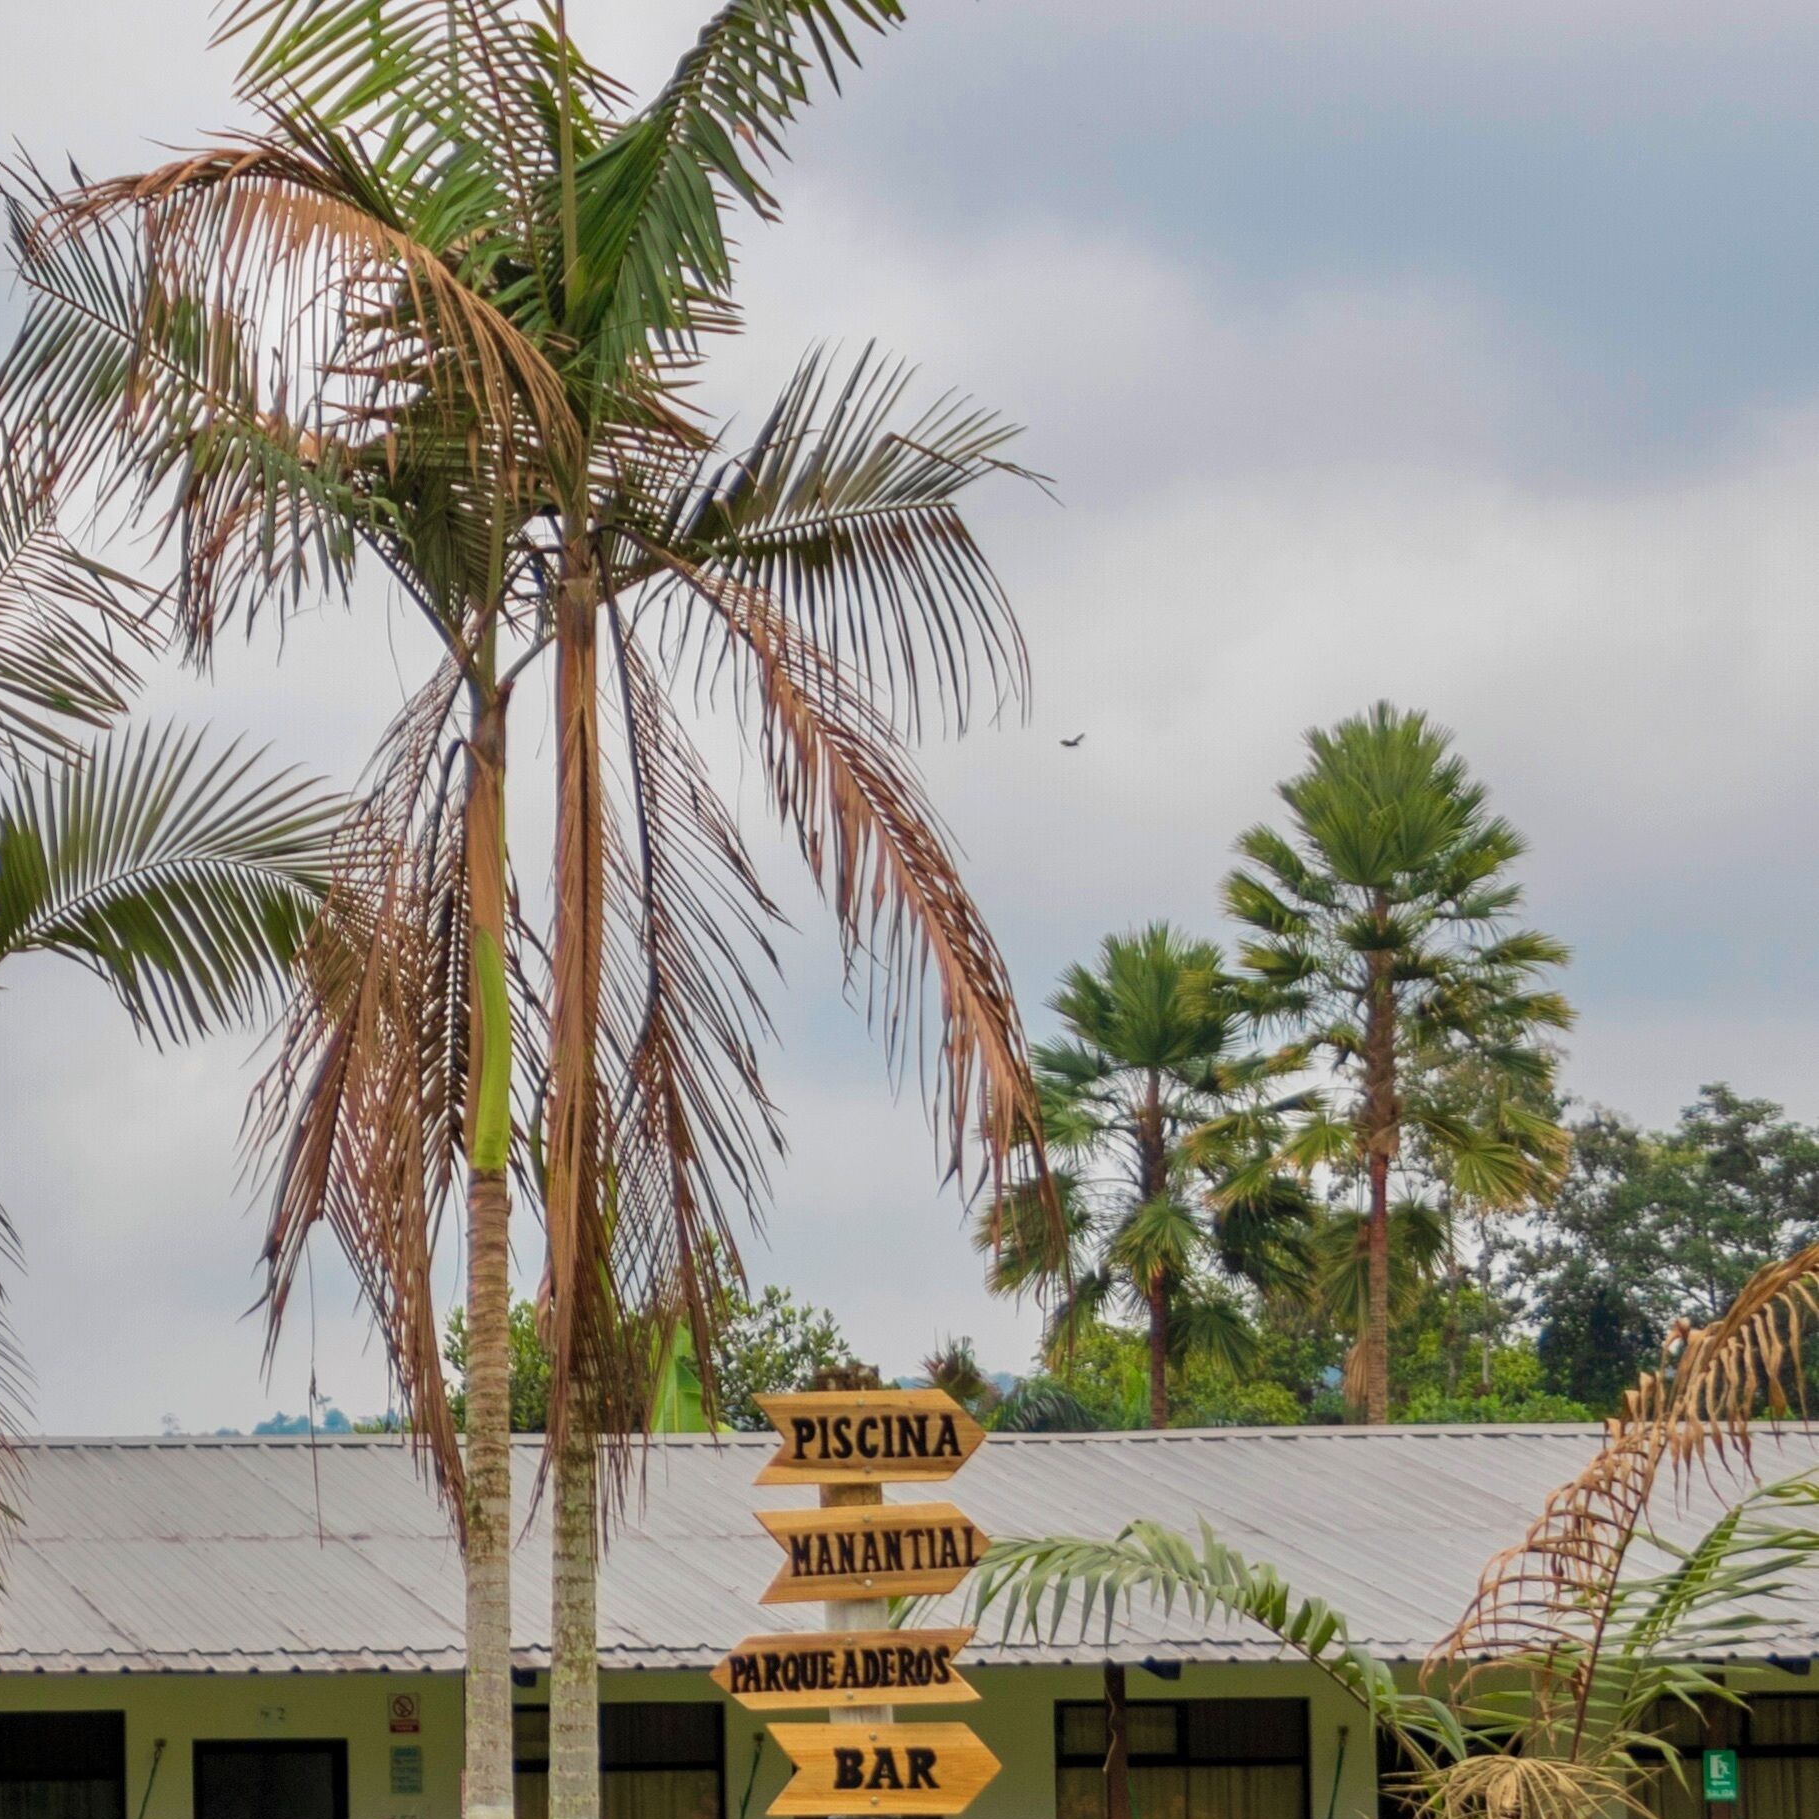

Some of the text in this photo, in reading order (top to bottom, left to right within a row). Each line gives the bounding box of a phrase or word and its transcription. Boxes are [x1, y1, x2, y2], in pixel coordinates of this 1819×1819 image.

[790, 1412, 963, 1460] PISCINA
[789, 1526, 981, 1577] MANANTIAL
[833, 1747, 941, 1790] BAR
